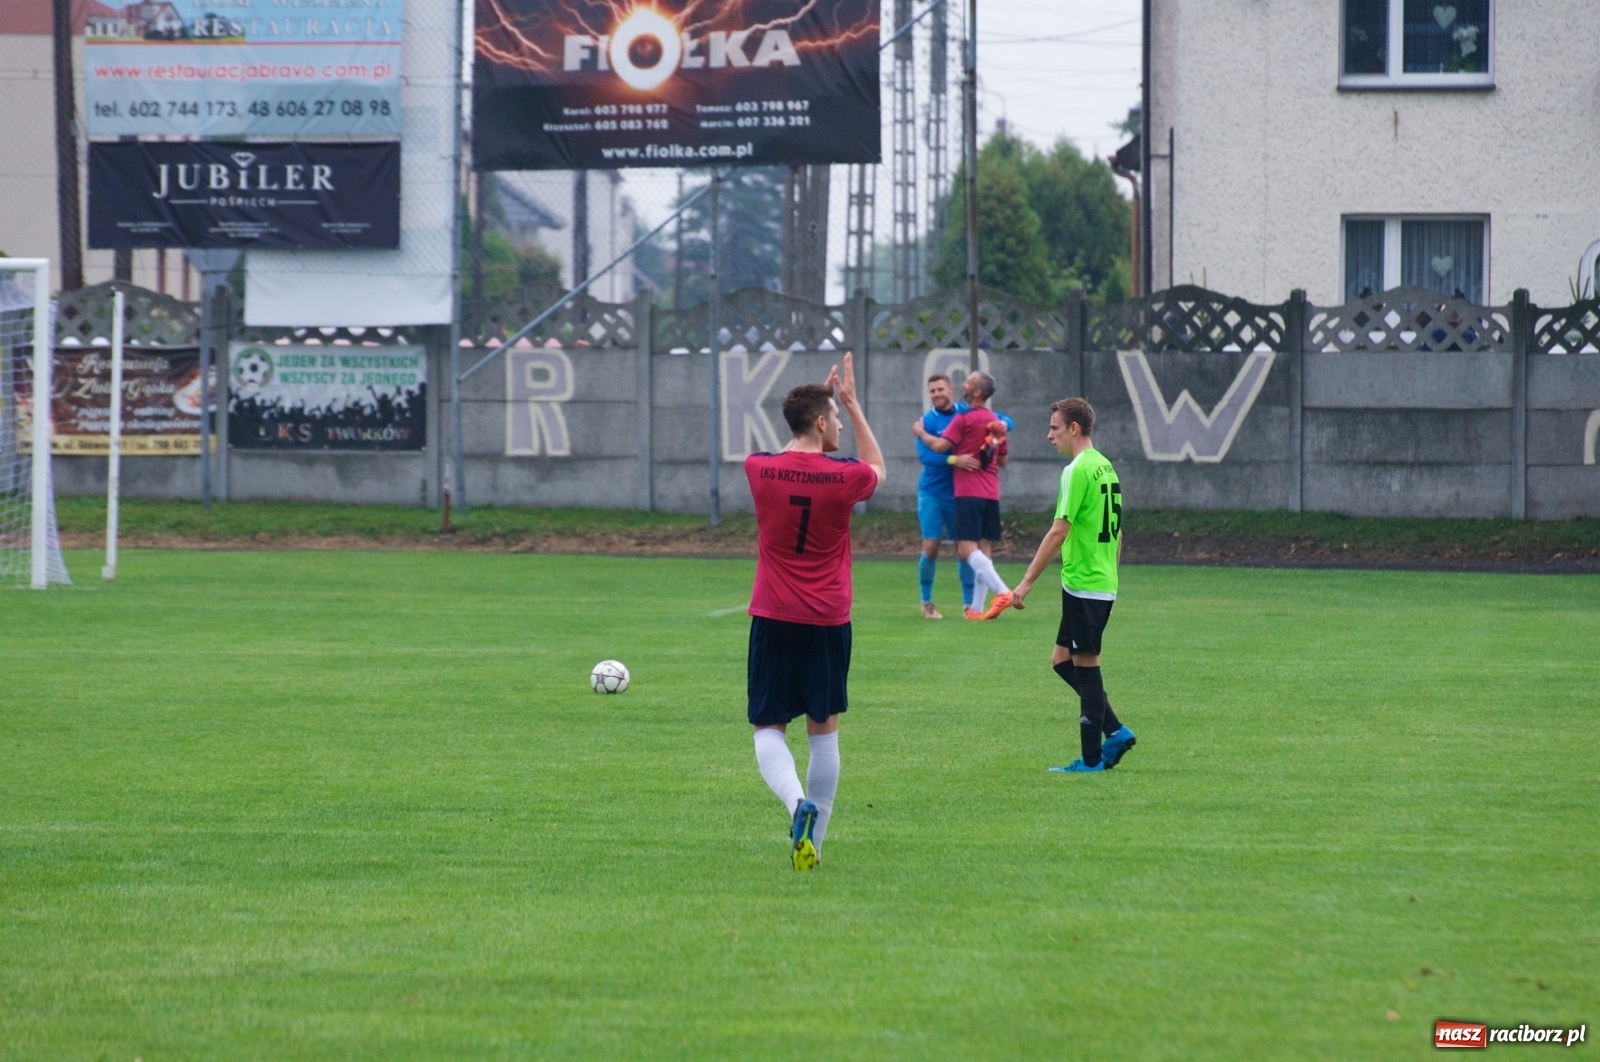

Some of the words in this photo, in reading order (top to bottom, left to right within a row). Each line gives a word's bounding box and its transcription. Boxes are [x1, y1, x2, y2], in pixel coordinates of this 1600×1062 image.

[193, 17, 394, 39] RESTAURACJA
[563, 7, 801, 90] FIOŁKA
[94, 62, 393, 82] www.restauracjabravo.com.pl
[94, 101, 122, 118] tel.
[129, 101, 161, 117] 602
[167, 101, 199, 116] 744
[247, 101, 270, 117] 48
[276, 101, 307, 117] 606
[314, 100, 335, 116] 27
[341, 100, 363, 116] 08
[369, 100, 391, 116] 98
[594, 104, 617, 116] 603
[735, 101, 759, 113] 603
[601, 141, 754, 160] www.fiolka.com.pl
[276, 355, 316, 368] JEDEN
[320, 355, 335, 368] ZA
[339, 355, 419, 369] WSZYSTKICH
[279, 371, 336, 384] WSZYSCY
[340, 371, 356, 384] ZA
[360, 371, 417, 385] JEDNEGO
[505, 347, 574, 458] R
[719, 350, 790, 463] K
[1117, 350, 1277, 464] W
[760, 466, 776, 480] LKS
[1097, 482, 1121, 543] 15
[788, 494, 812, 554] 7
